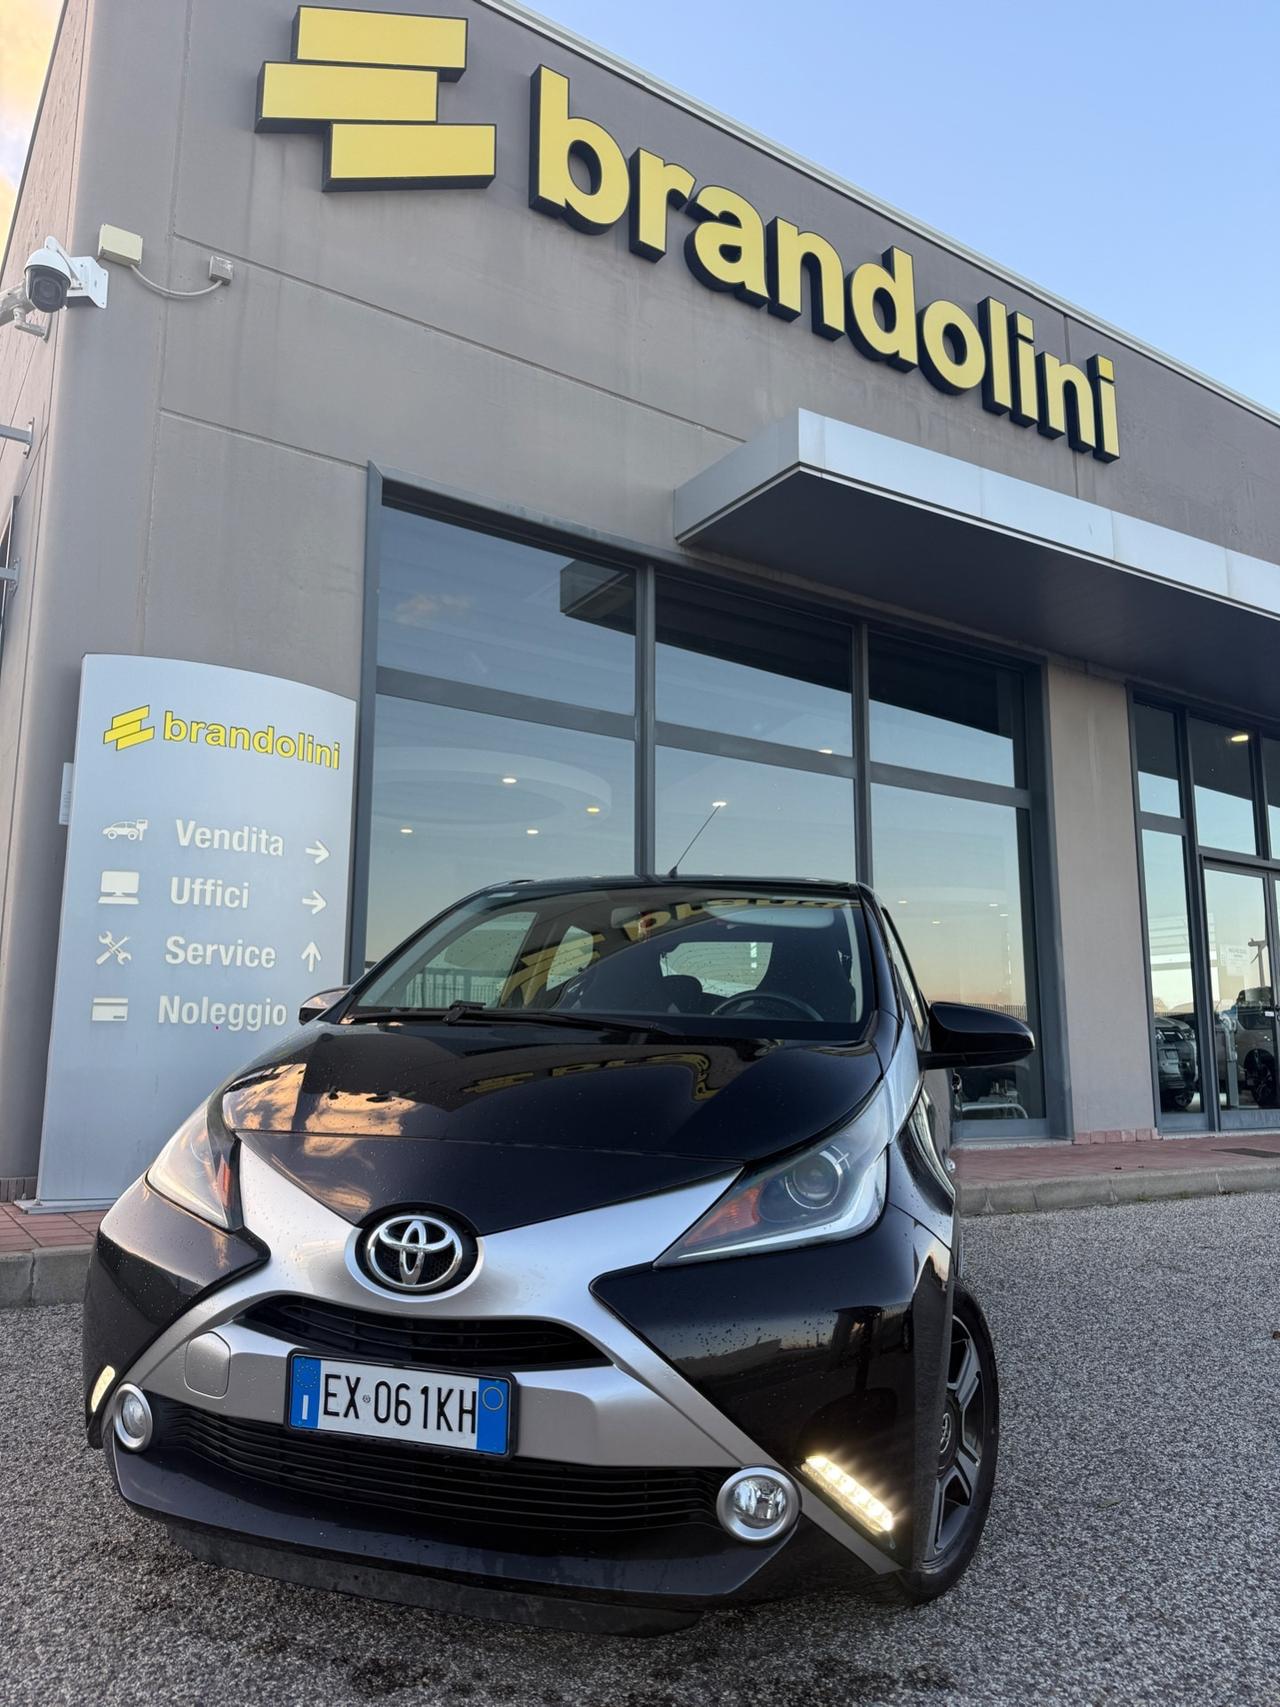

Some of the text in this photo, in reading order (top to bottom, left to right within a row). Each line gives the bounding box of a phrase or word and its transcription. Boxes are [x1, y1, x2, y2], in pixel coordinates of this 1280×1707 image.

[529, 64, 1120, 463] brandolini
[163, 710, 341, 769] brandolini
[175, 818, 284, 857] Vendita
[170, 876, 250, 909] Uffici
[165, 935, 276, 969] Service
[157, 995, 287, 1032] Noleggio
